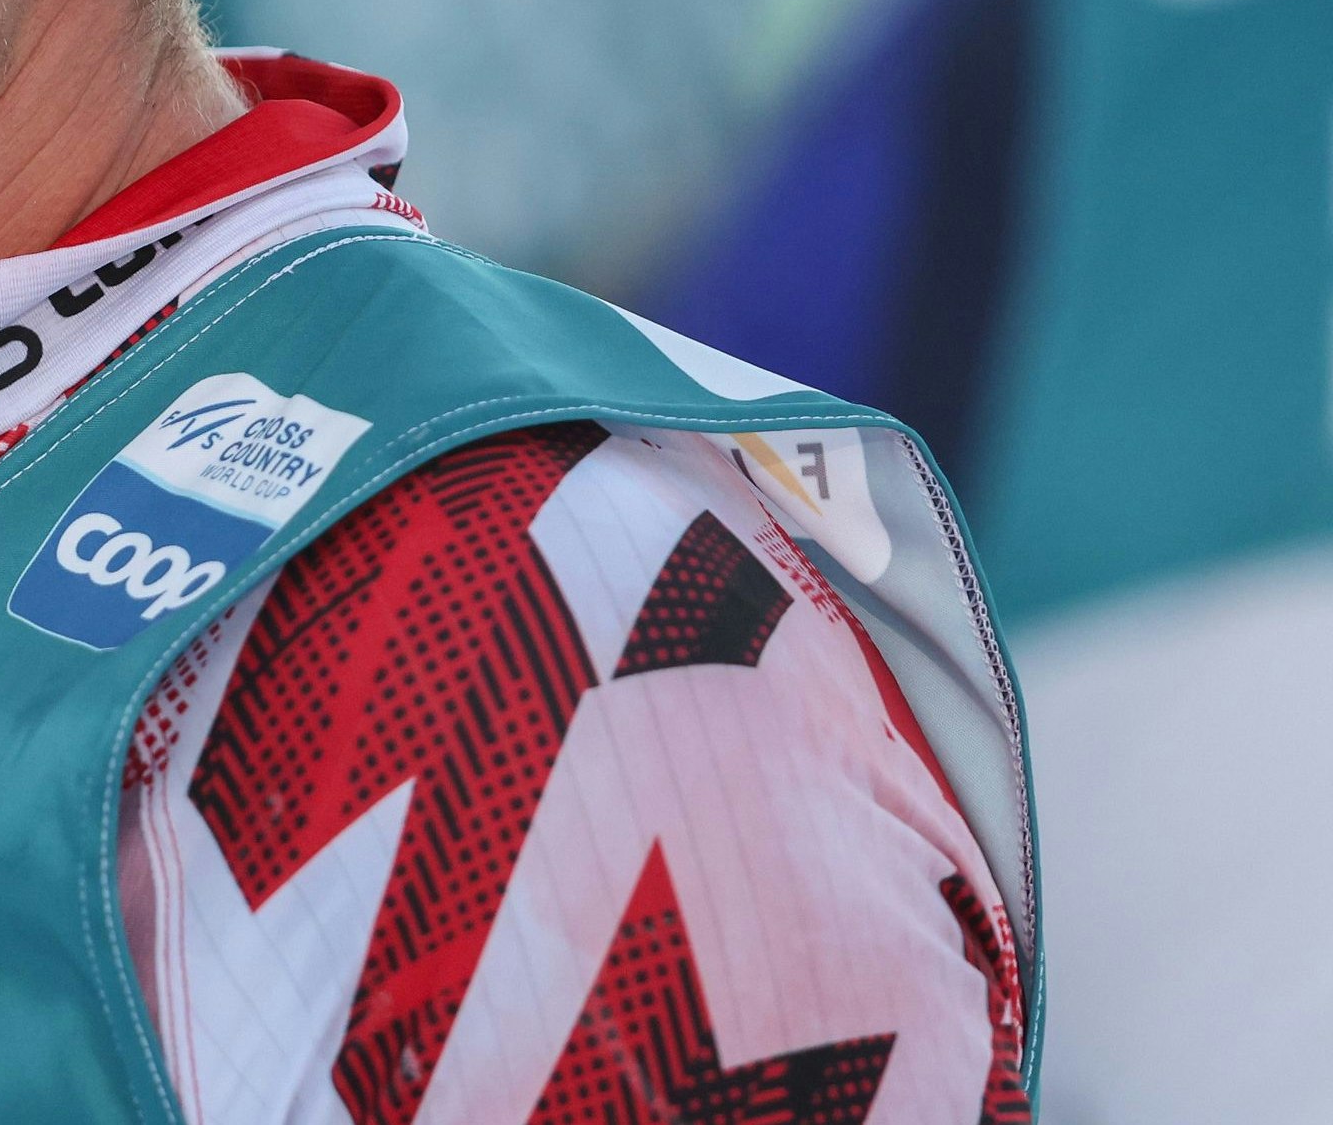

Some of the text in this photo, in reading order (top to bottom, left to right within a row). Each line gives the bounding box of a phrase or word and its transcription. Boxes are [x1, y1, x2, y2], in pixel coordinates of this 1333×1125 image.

[161, 410, 221, 450] FIS
[200, 463, 290, 501] WORLD CUP
[219, 441, 323, 487] COUNTRY
[56, 512, 226, 620] coop
